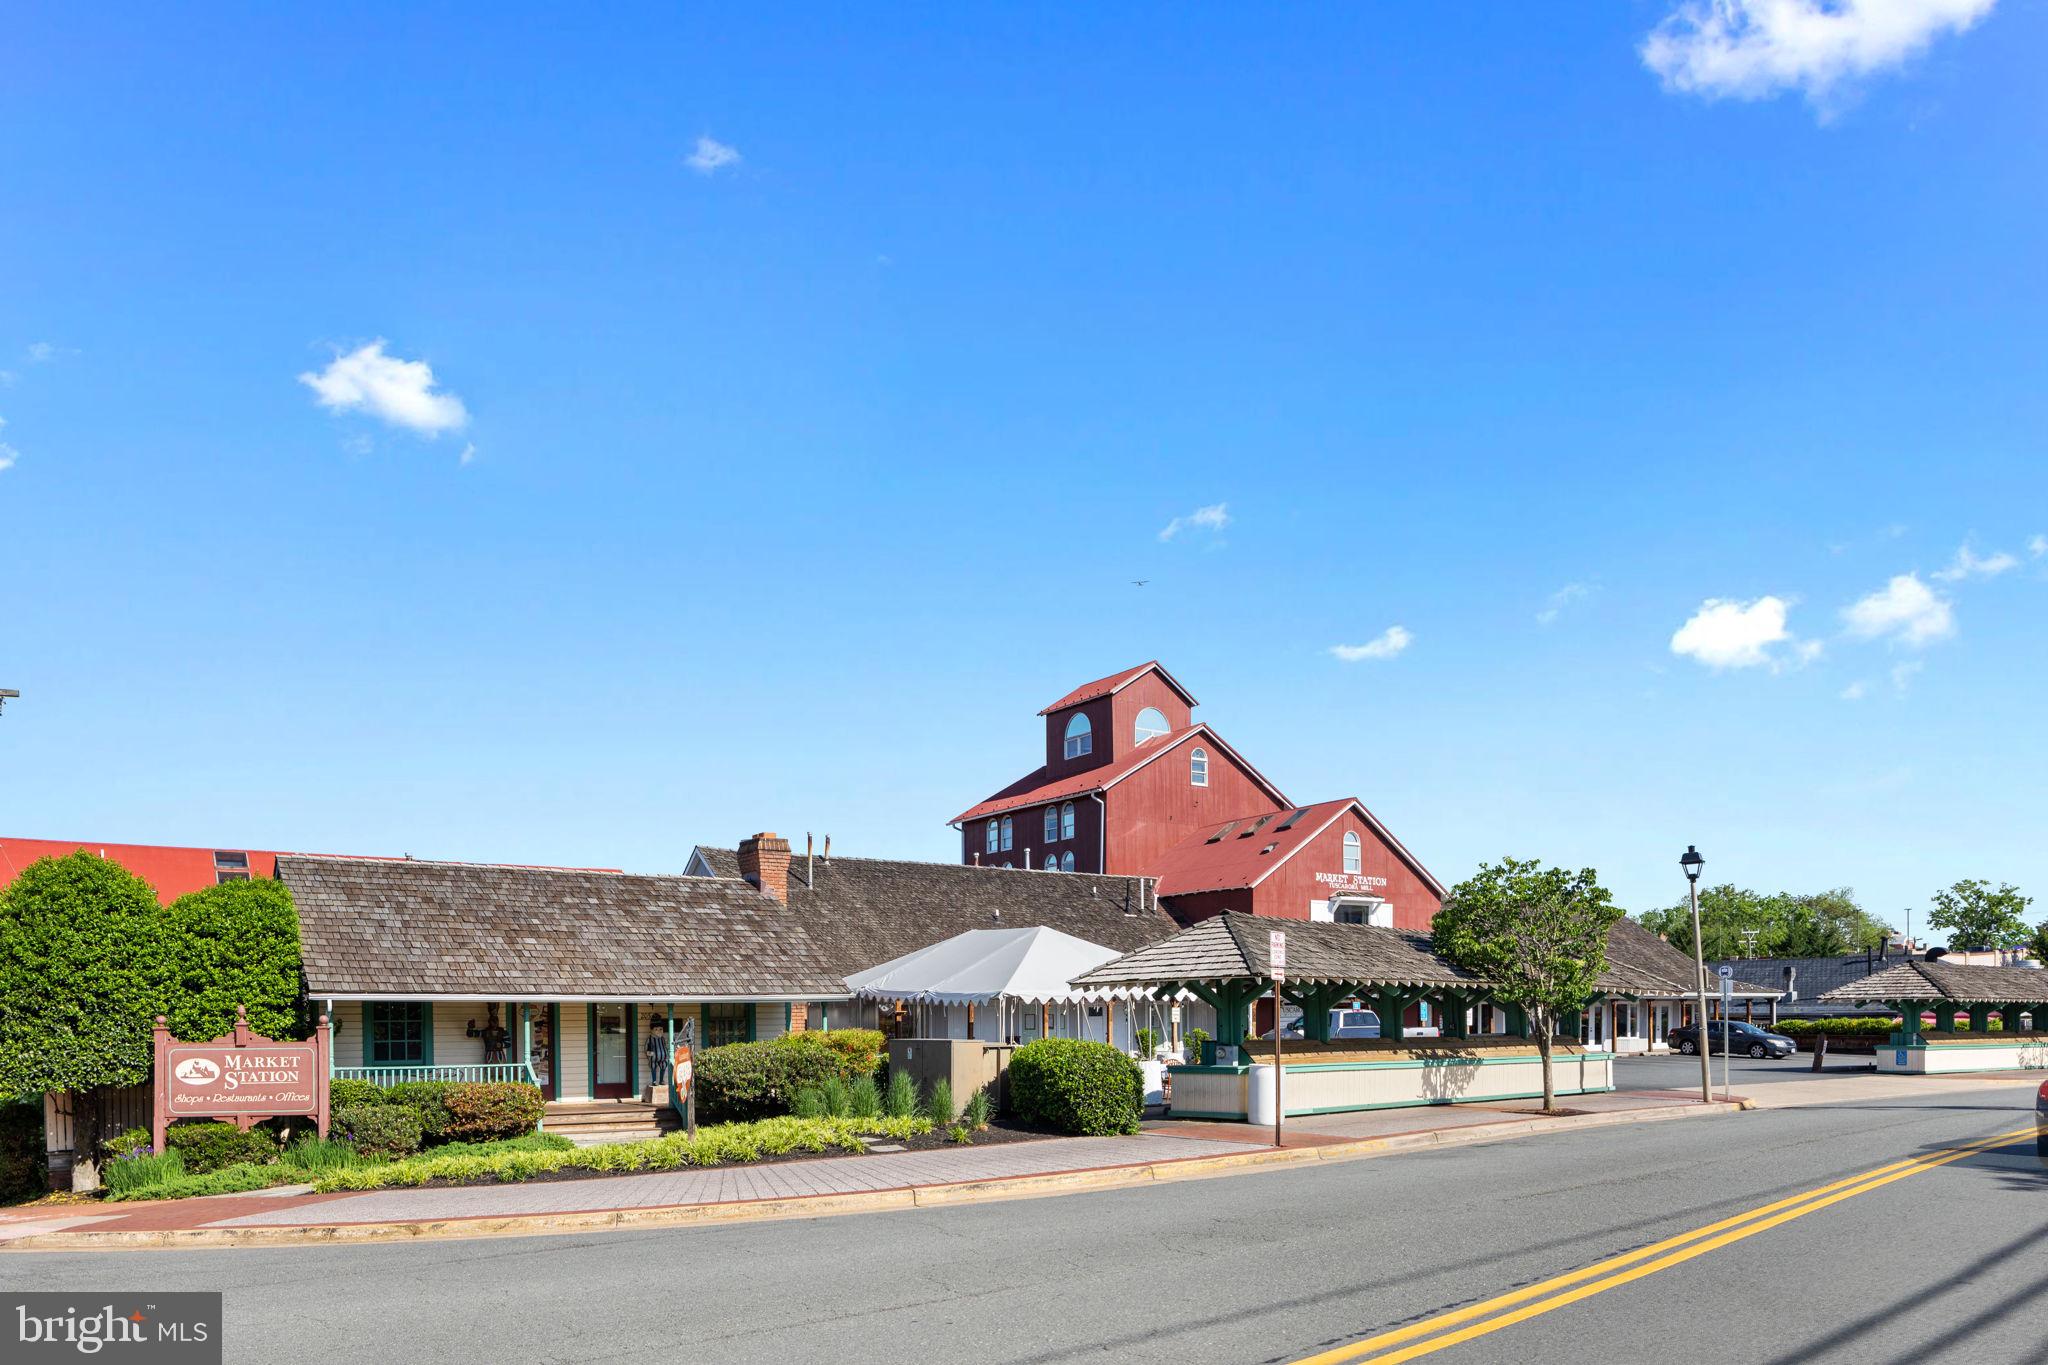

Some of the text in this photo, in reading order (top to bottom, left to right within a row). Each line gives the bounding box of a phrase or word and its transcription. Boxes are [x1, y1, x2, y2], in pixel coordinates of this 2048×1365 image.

[1316, 872, 1387, 886] MARKET STATION
[224, 1055, 300, 1070] MARKET
[224, 1070, 300, 1090] STATION
[174, 1091, 310, 1105] Shops Restaurants Offices
